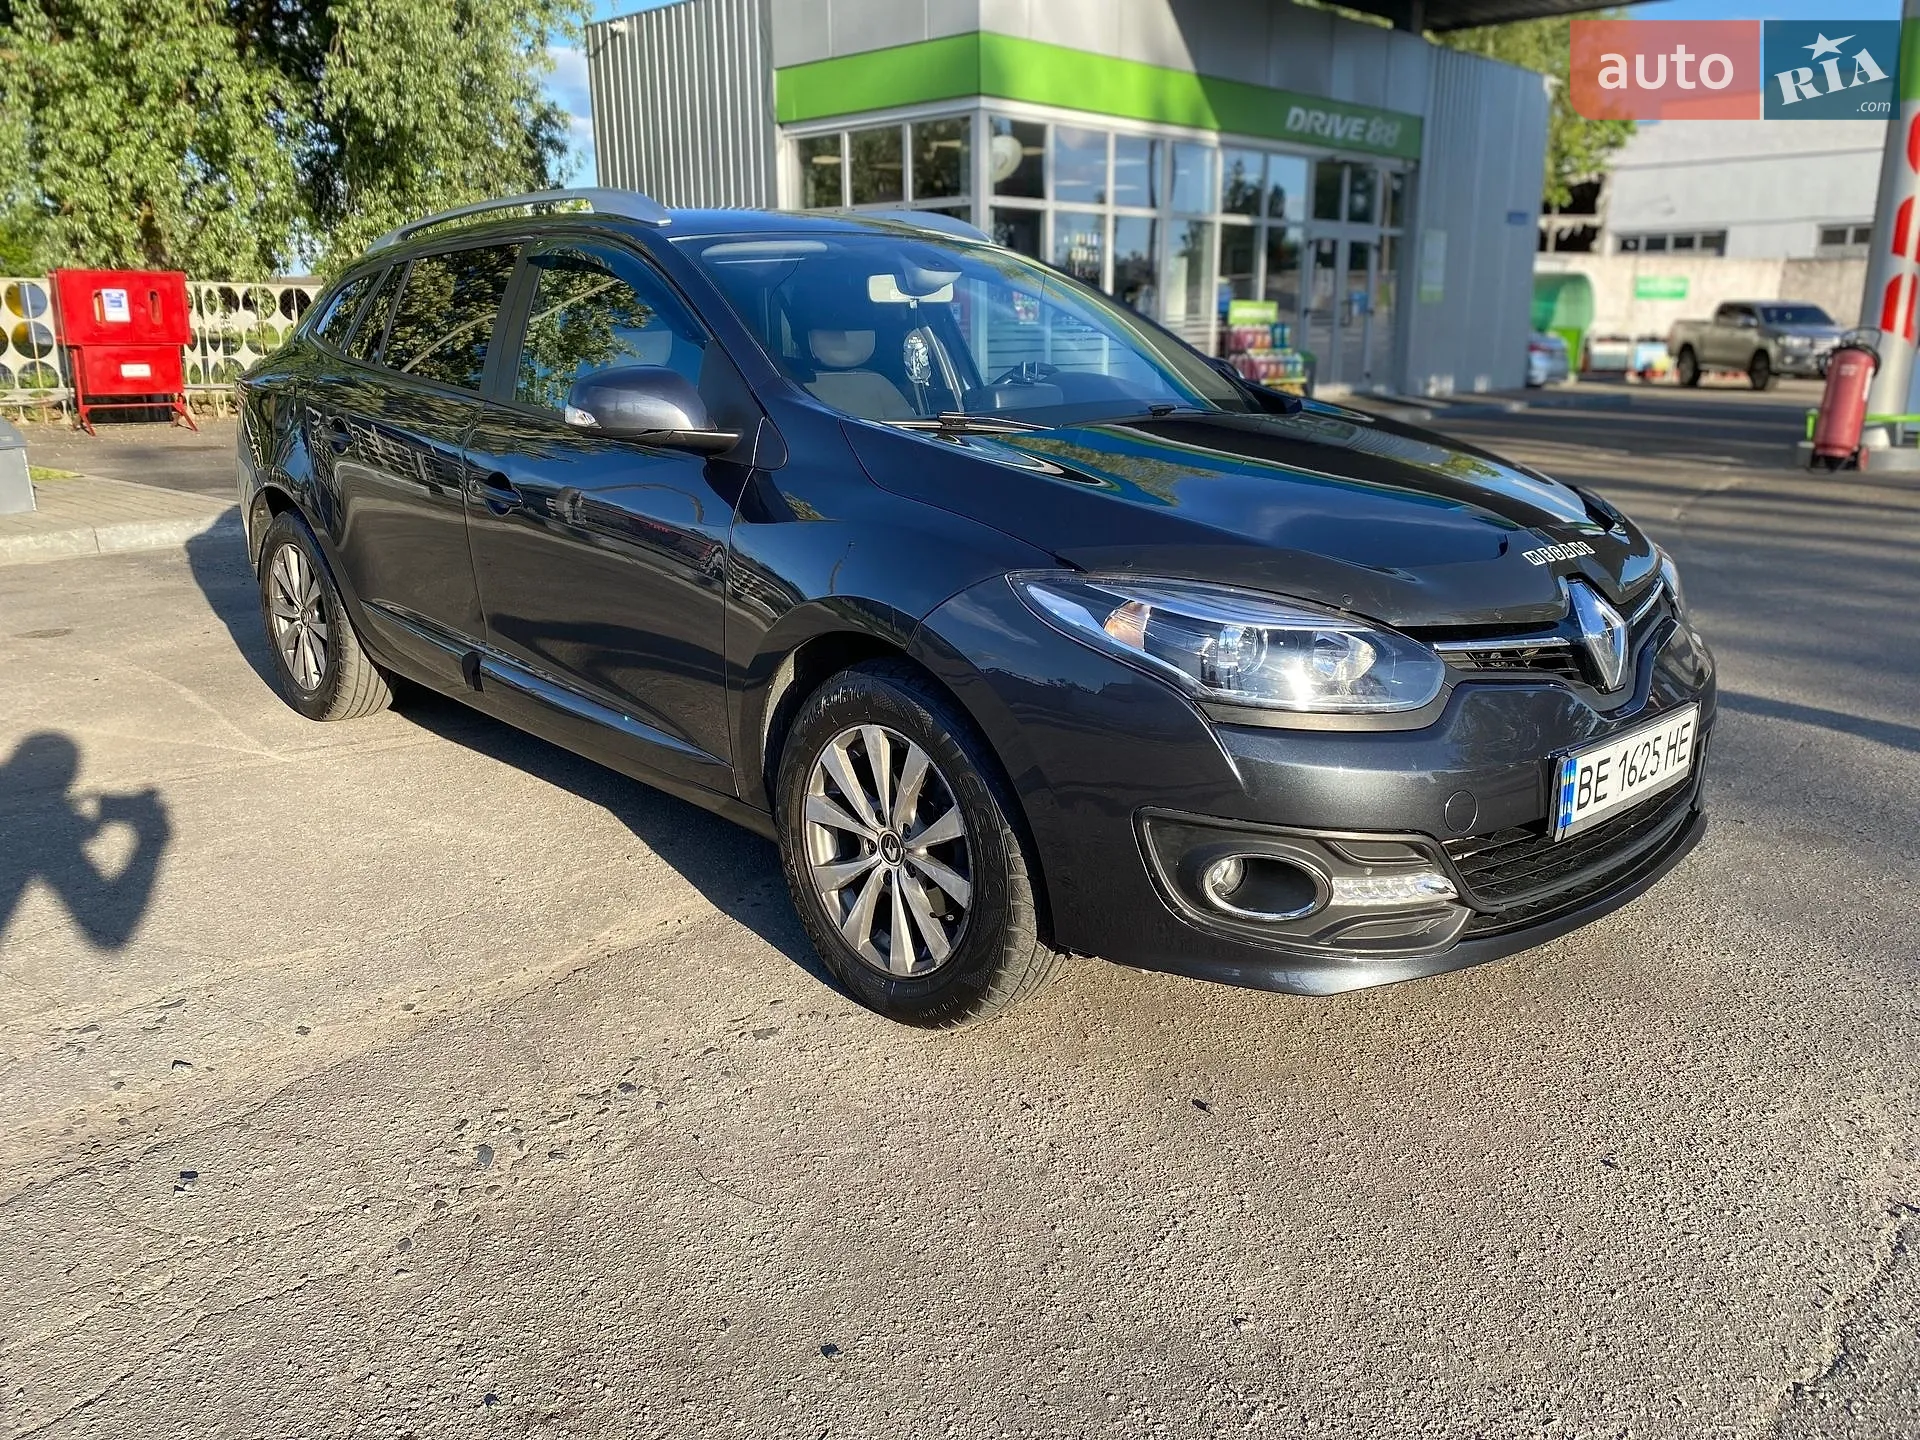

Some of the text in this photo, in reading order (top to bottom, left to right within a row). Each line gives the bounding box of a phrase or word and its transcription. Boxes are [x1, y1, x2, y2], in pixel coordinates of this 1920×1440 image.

[1285, 105, 1366, 142] DRIVE
[1521, 541, 1597, 566] MEGANE
[1576, 721, 1692, 811] BE 1625 HE
